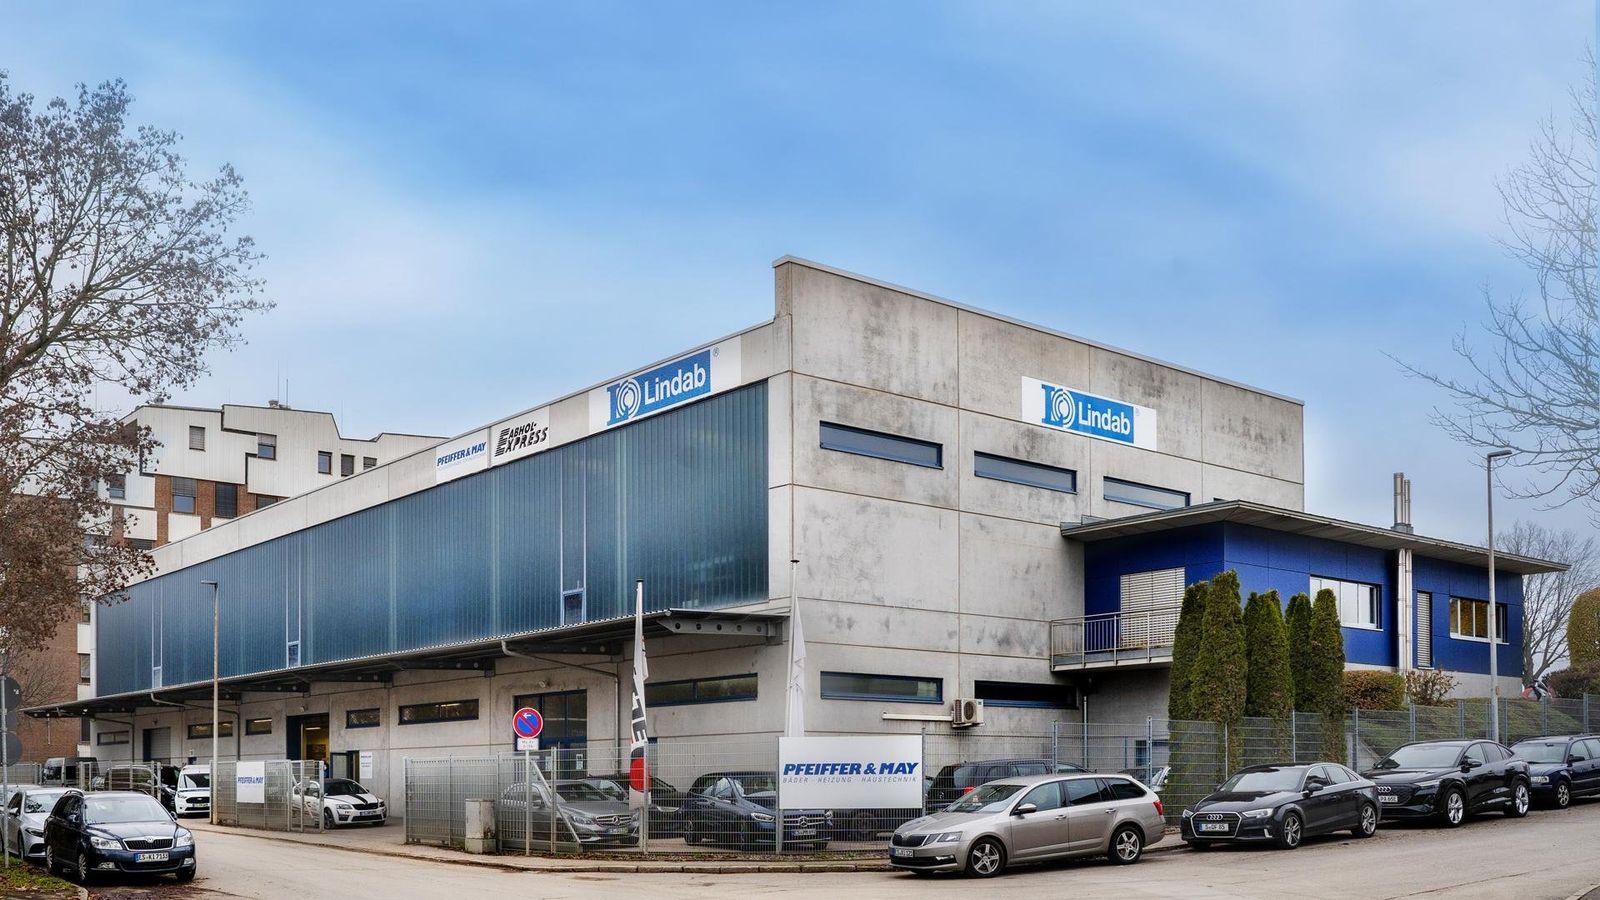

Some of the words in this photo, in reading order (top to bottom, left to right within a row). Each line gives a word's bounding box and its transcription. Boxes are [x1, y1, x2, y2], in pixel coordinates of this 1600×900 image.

[644, 363, 706, 405] Lindab
[508, 421, 537, 439] ABHOL-
[1078, 401, 1131, 435] Lindab
[437, 449, 466, 466] PFEIFFER
[465, 447, 471, 456] &
[471, 441, 487, 454] MAY
[495, 427, 548, 457] EXPRESS
[783, 763, 861, 775] PFEIFFER
[864, 763, 876, 775] &
[880, 762, 919, 775] MAY
